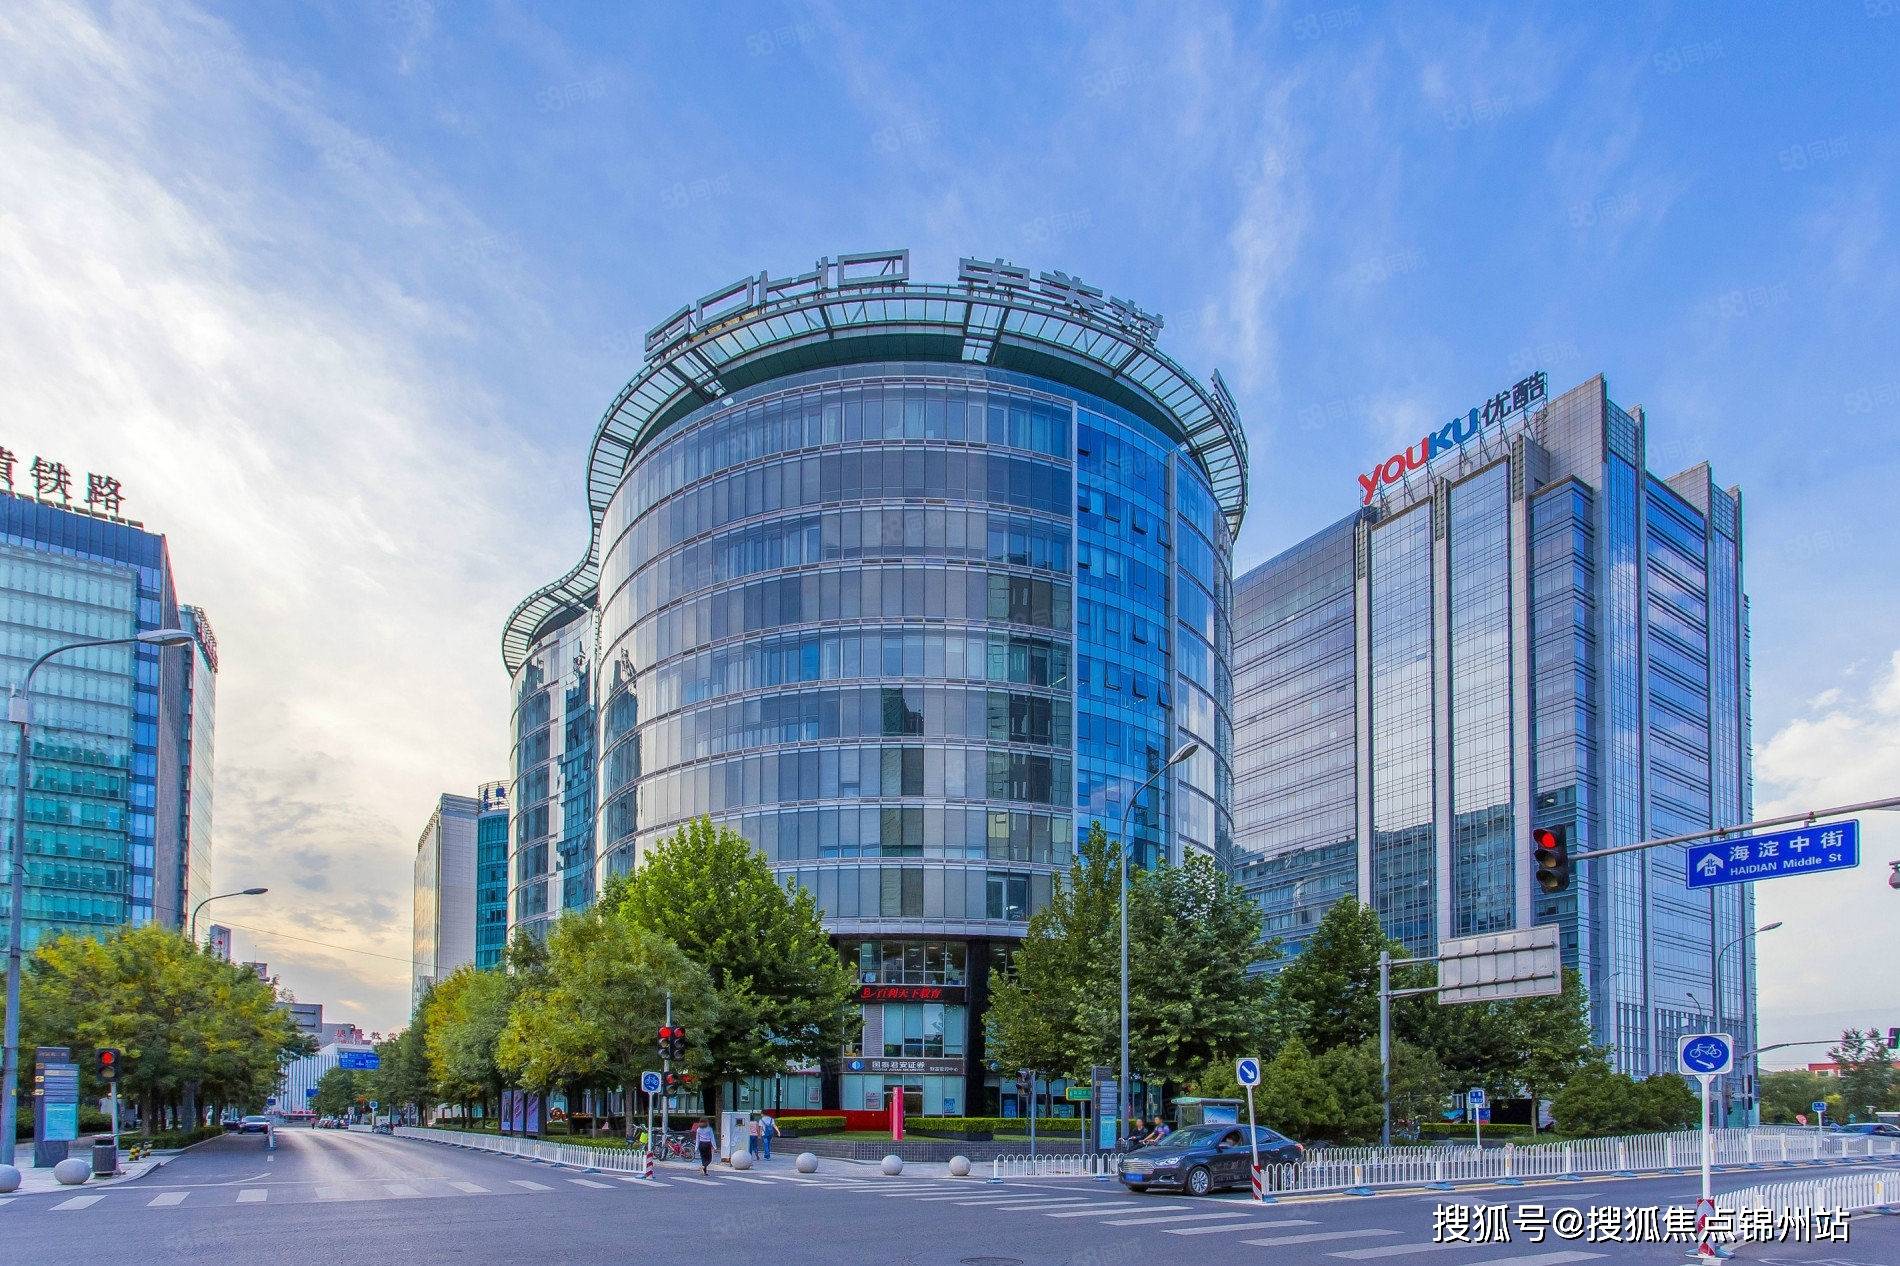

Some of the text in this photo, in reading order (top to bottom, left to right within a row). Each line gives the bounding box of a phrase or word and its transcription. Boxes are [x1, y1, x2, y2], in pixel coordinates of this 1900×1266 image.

[1358, 371, 1547, 505] YOUKU 优酷
[1729, 830, 1843, 862] 海淀中街
[1730, 854, 1842, 876] HAIDIAN Middle St
